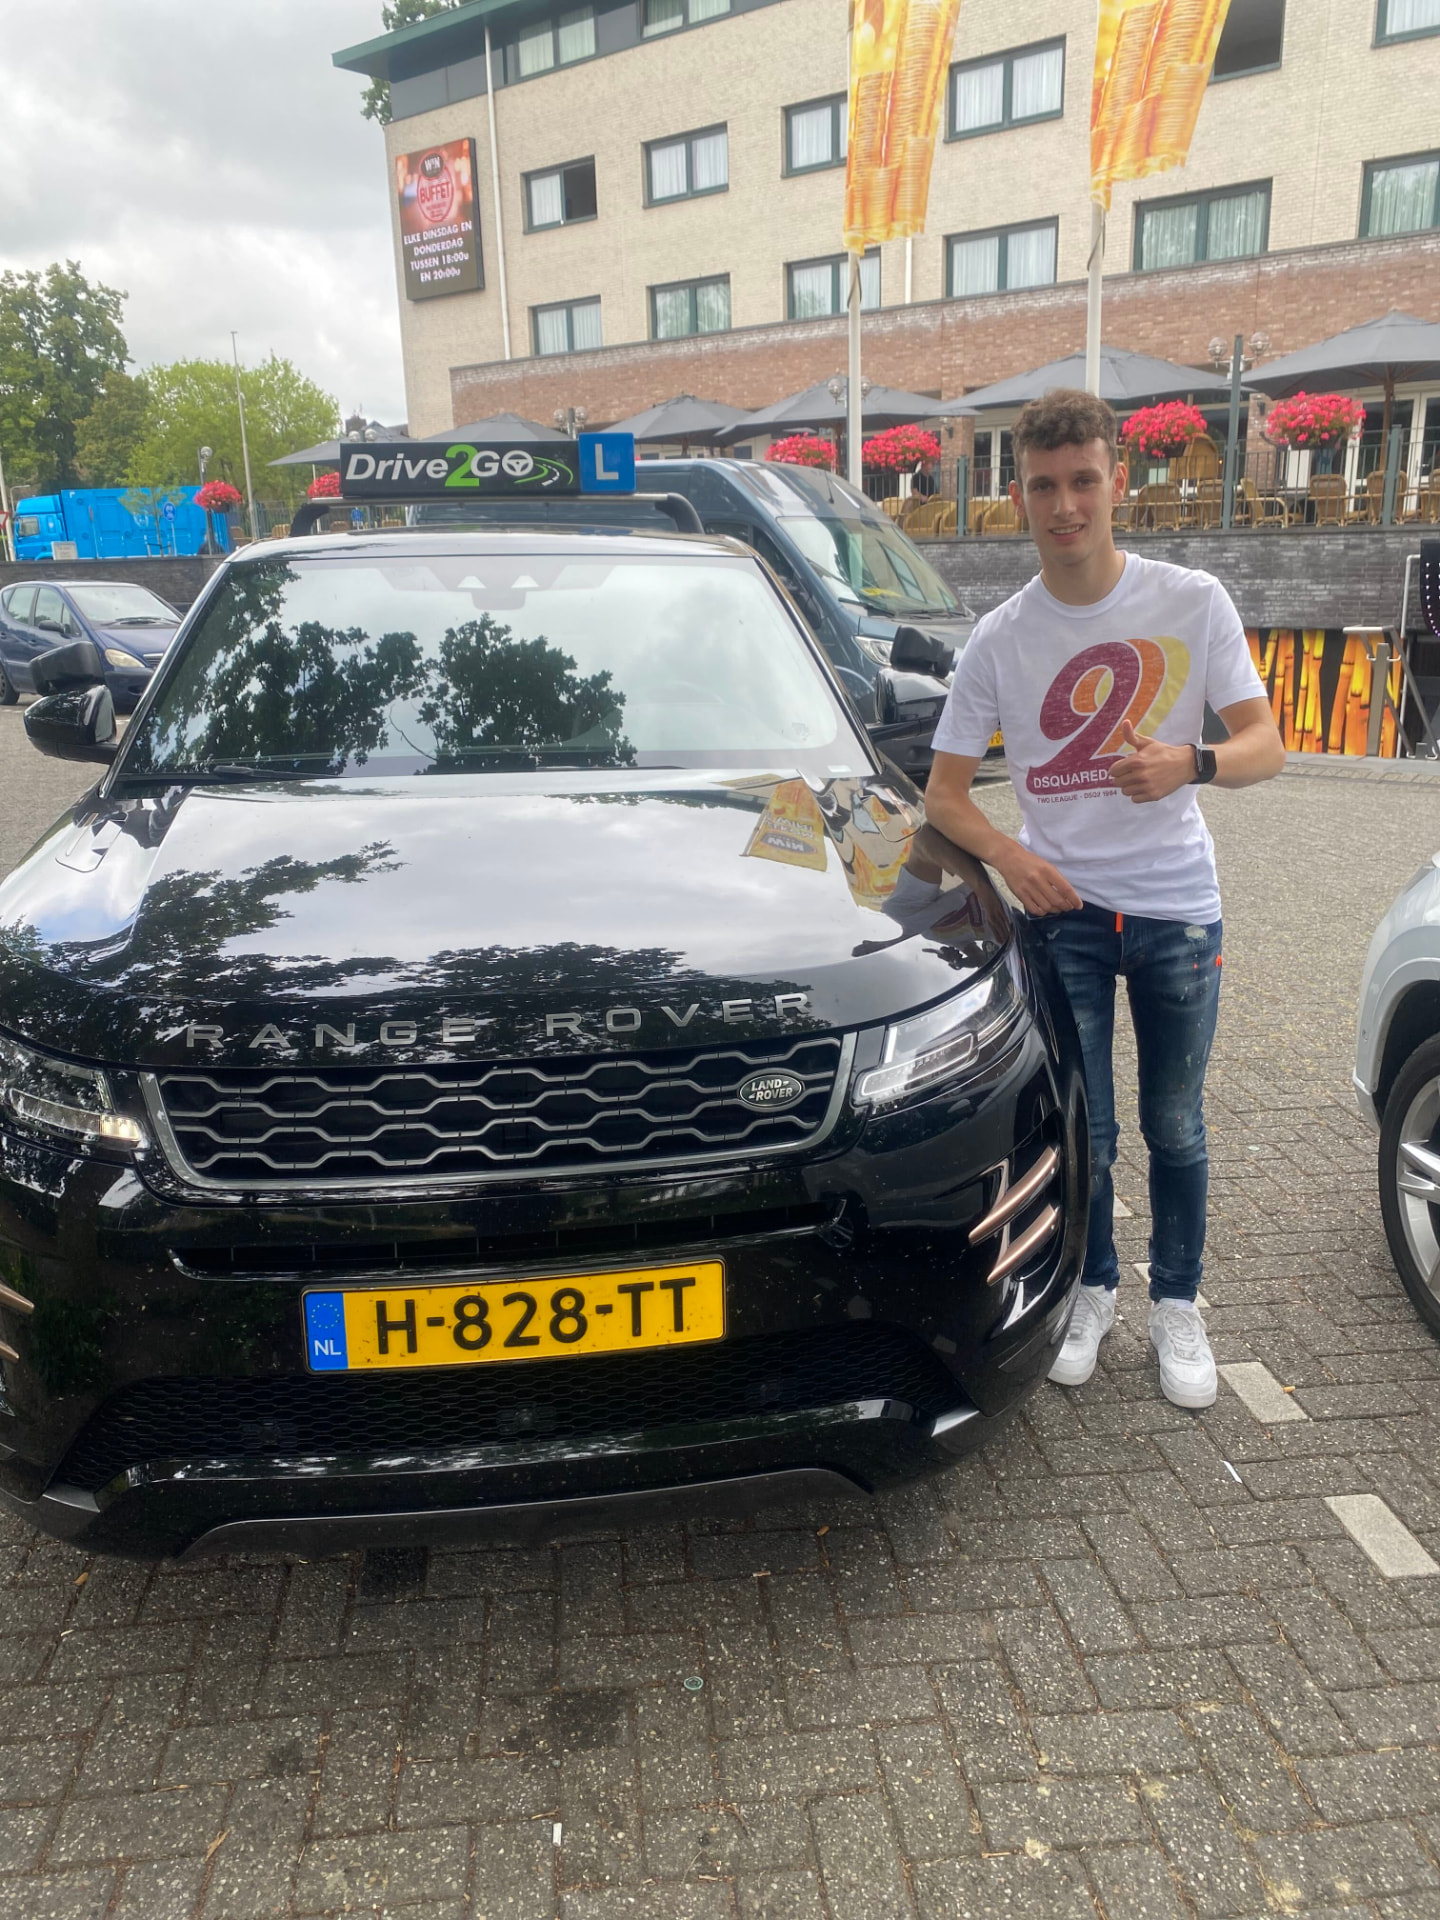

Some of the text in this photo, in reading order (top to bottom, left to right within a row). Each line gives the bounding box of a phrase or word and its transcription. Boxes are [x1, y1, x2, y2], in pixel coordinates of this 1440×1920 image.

[420, 182, 450, 203] BUFFET
[404, 220, 473, 245] ELKE DINSDAG EN
[413, 238, 463, 255] DONDERDAG
[410, 256, 439, 271] TUSSEN
[420, 271, 431, 283] EN
[594, 443, 619, 480] L
[1051, 793, 1078, 803] LEAGUE
[186, 992, 810, 1049] RANGE ROVER
[751, 1078, 783, 1092] LAND
[755, 1087, 793, 1101] ROVER
[375, 1276, 696, 1355] H-828-TT
[314, 1340, 342, 1356] NL
